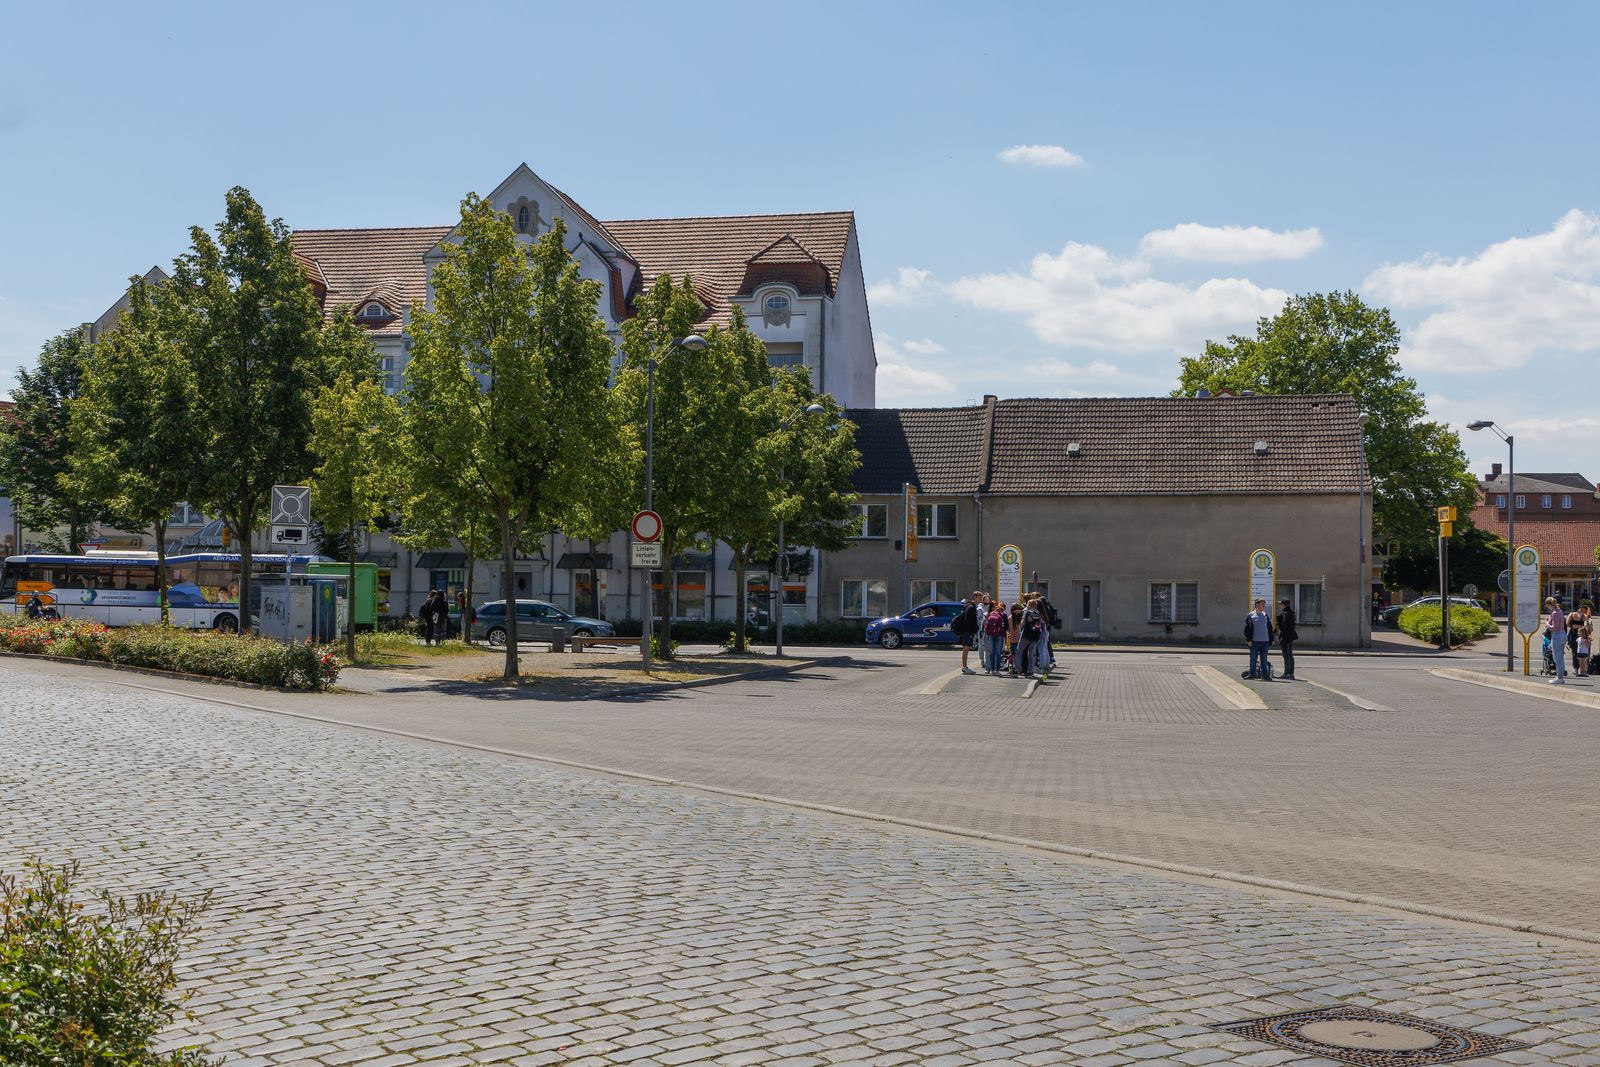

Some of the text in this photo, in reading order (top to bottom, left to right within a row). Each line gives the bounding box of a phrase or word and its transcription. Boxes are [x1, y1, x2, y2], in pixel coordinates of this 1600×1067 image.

[1014, 562, 1020, 570] 3
[1535, 563, 1538, 571] 1
[1268, 567, 1273, 575] 2
